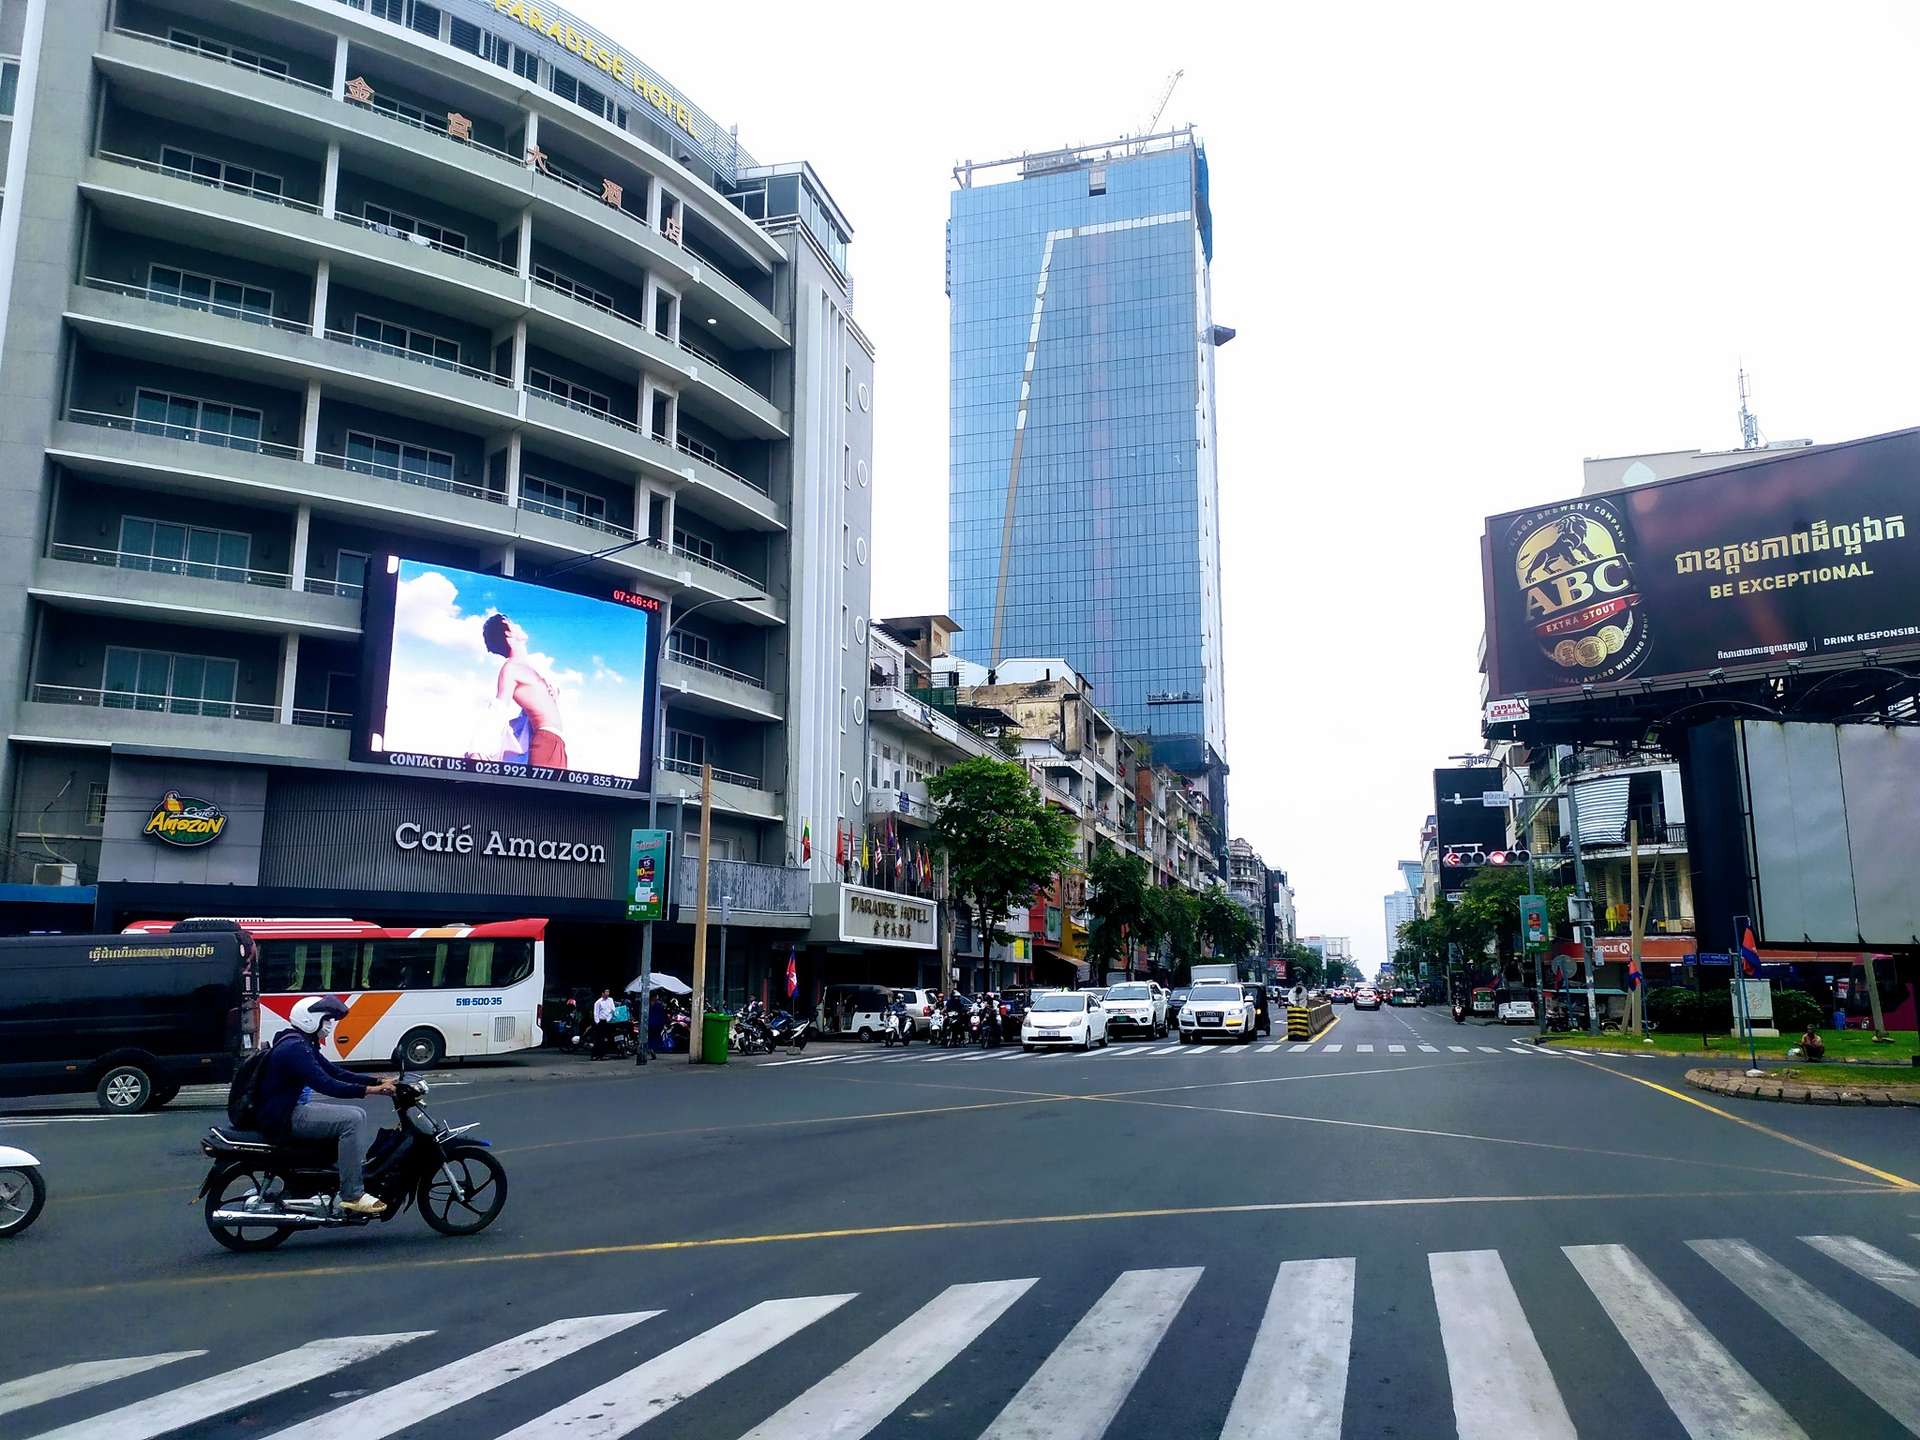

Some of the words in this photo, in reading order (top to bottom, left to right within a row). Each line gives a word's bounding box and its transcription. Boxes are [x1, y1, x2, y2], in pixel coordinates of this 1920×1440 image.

[631, 71, 699, 140] HOTEL
[1593, 506, 1626, 543] COMPANY
[1526, 559, 1630, 621] ABC
[1709, 583, 1734, 599] BE
[1738, 561, 1874, 594] EXCEPTIONAL
[613, 590, 658, 610] 07:46:41
[1545, 616, 1580, 633] EXTRA
[1582, 602, 1617, 621] STOUT
[1823, 634, 1855, 646] DRINK
[1857, 626, 1920, 641] RESPONSIBL
[1615, 640, 1645, 670] WINNING
[389, 753, 443, 769] CONTACT
[446, 758, 467, 771] US:
[475, 762, 500, 775] 023
[503, 764, 528, 777] 992
[532, 767, 554, 780] 777
[568, 772, 590, 783] 069
[592, 775, 612, 787] 855
[614, 777, 634, 790] 777
[395, 822, 474, 854] Café
[483, 830, 606, 863] Amazon
[851, 896, 898, 919] PARADISE
[900, 905, 929, 924] HOTEL
